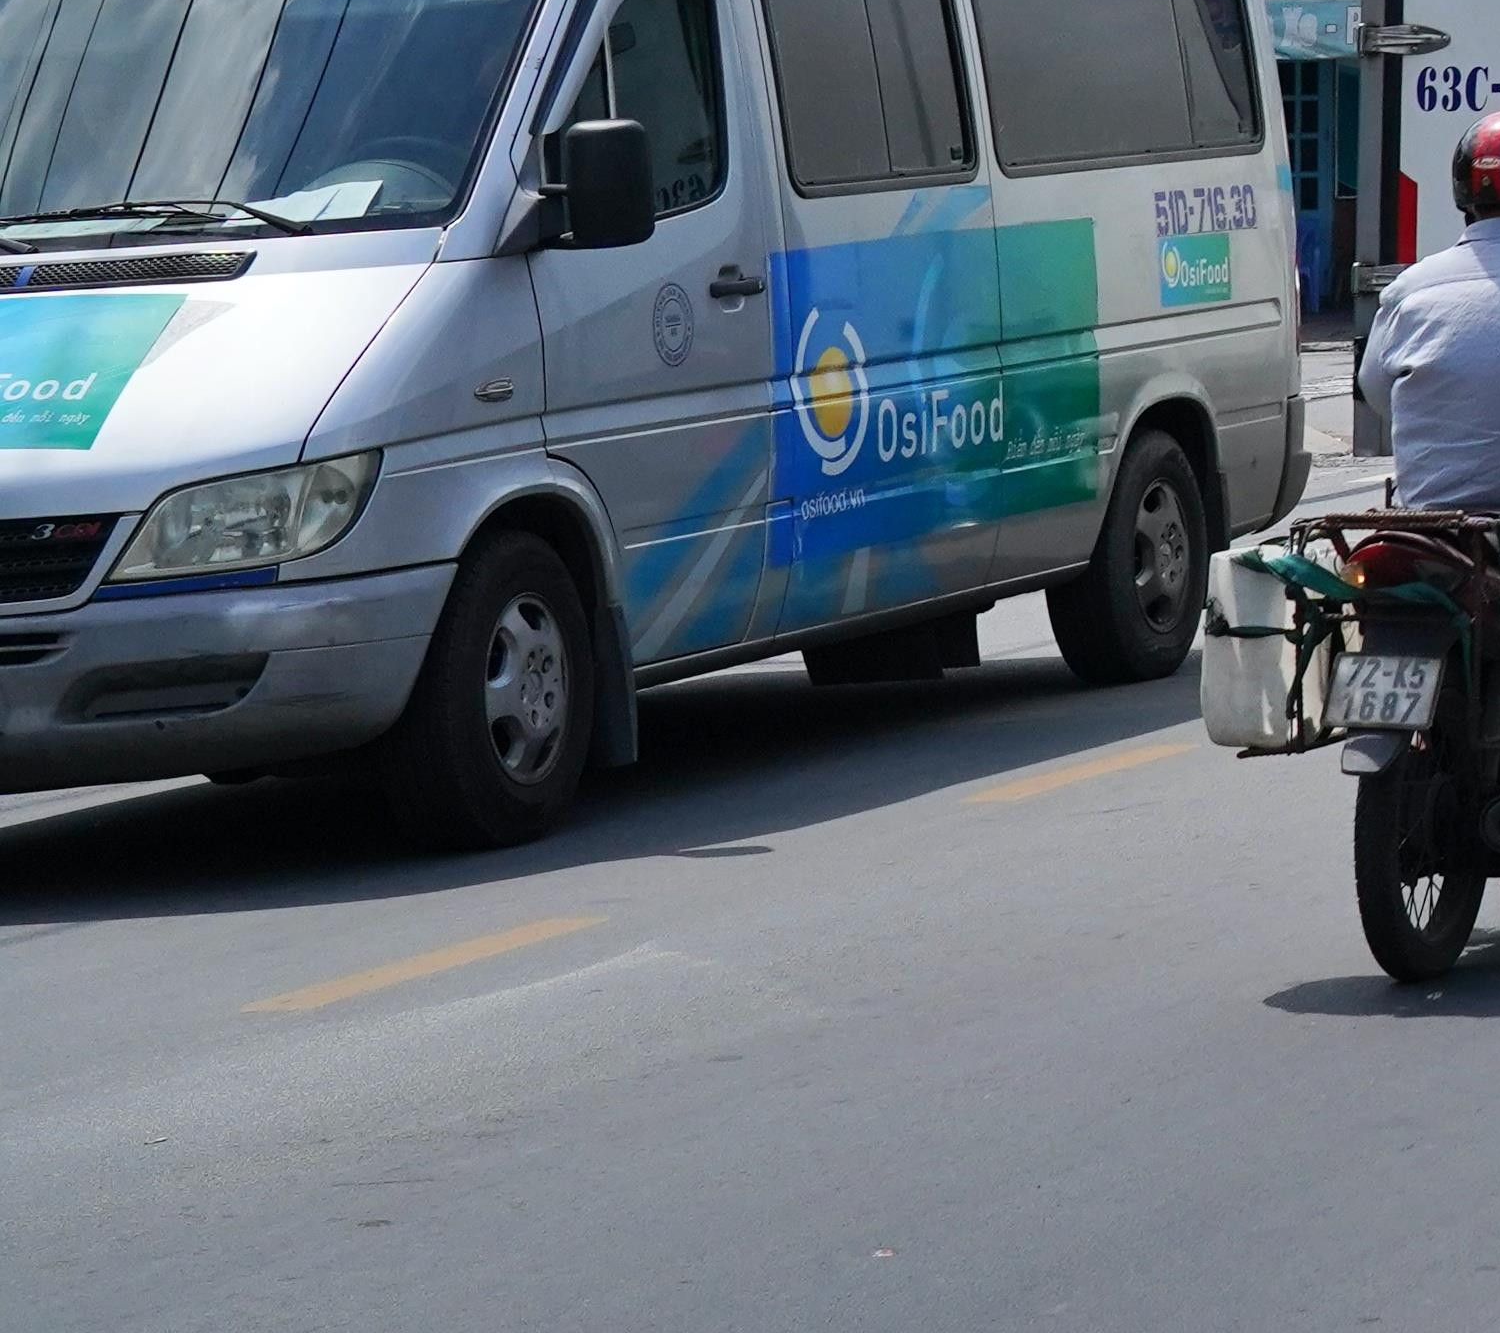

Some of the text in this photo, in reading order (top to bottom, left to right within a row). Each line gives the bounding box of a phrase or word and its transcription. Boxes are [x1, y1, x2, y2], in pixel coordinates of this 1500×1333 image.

[1153, 184, 1257, 237] 51D-716.30
[1179, 253, 1230, 287] OsiFood
[877, 378, 1006, 462] OsiFood
[1344, 654, 1426, 688] 72-K5
[1342, 689, 1423, 724] 1687
